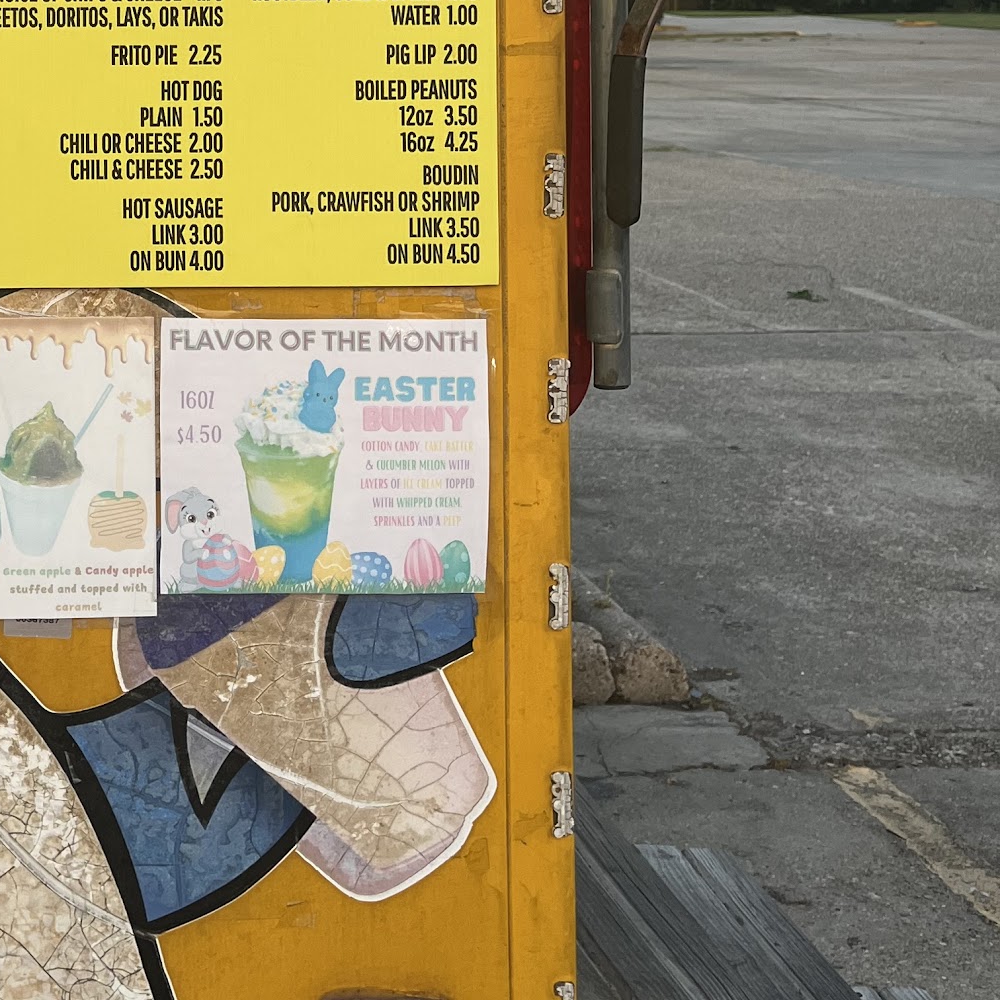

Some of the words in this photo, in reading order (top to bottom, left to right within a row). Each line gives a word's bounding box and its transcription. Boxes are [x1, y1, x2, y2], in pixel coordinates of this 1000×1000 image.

[386, 44, 411, 64] PIG
[414, 44, 437, 64] LIP
[443, 44, 478, 64] 2.00
[355, 80, 407, 100] BOILED
[410, 79, 478, 100] PEANUTS
[271, 192, 314, 215] PORK,
[317, 191, 394, 212] CRAWFISH
[398, 191, 419, 211] OR
[421, 191, 480, 211] SHRIMP
[169, 328, 272, 351] FLAVOR
[280, 329, 316, 350] OF
[322, 330, 371, 351] THE
[379, 330, 478, 352] MONTH
[354, 376, 475, 402] EASTER
[362, 406, 469, 432] BUNNY
[177, 425, 222, 445] $4.50
[366, 460, 373, 470] &
[376, 460, 416, 470] CUCUMBER
[419, 460, 446, 470] MELON
[449, 460, 469, 470] WITH
[3, 568, 35, 576] Green
[40, 567, 70, 578] apple
[75, 567, 81, 575] &
[86, 566, 118, 576] Candy
[123, 565, 154, 577] apple
[10, 584, 53, 594] stuffed
[58, 584, 76, 593] and
[81, 583, 118, 595] topped
[123, 583, 147, 592] with
[56, 602, 102, 612] caramel
